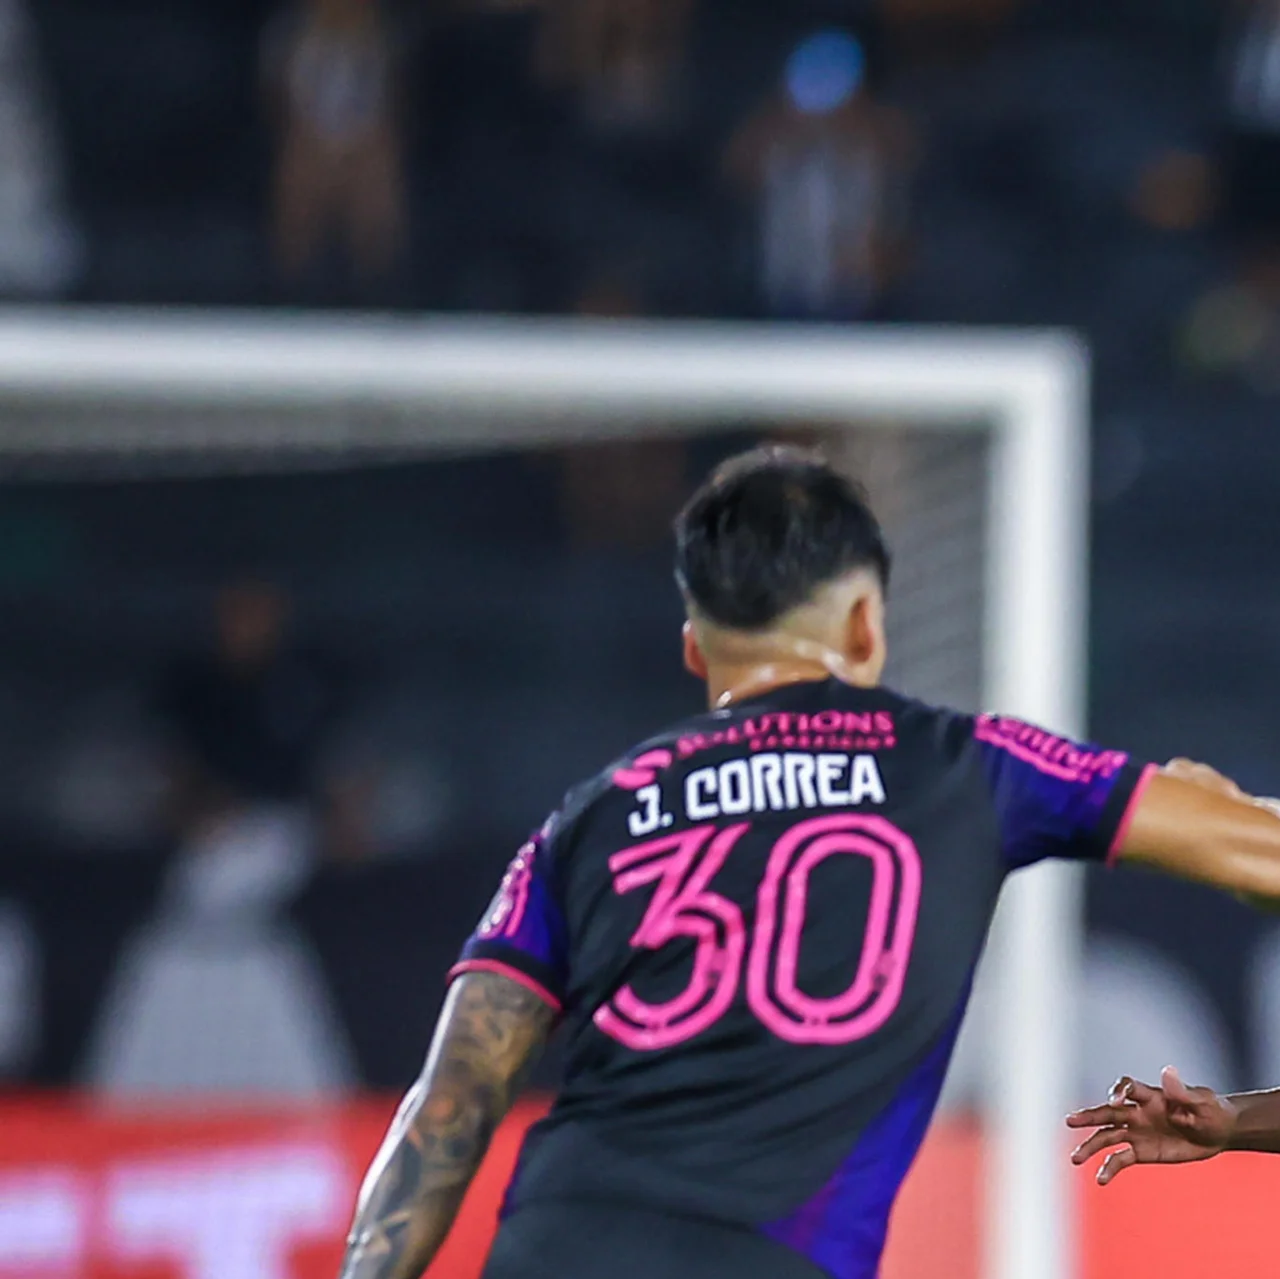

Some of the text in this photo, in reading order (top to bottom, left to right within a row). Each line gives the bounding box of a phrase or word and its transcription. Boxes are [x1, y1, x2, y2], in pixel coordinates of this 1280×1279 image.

[627, 752, 887, 835] J. CORREA
[593, 812, 922, 1050] 30
